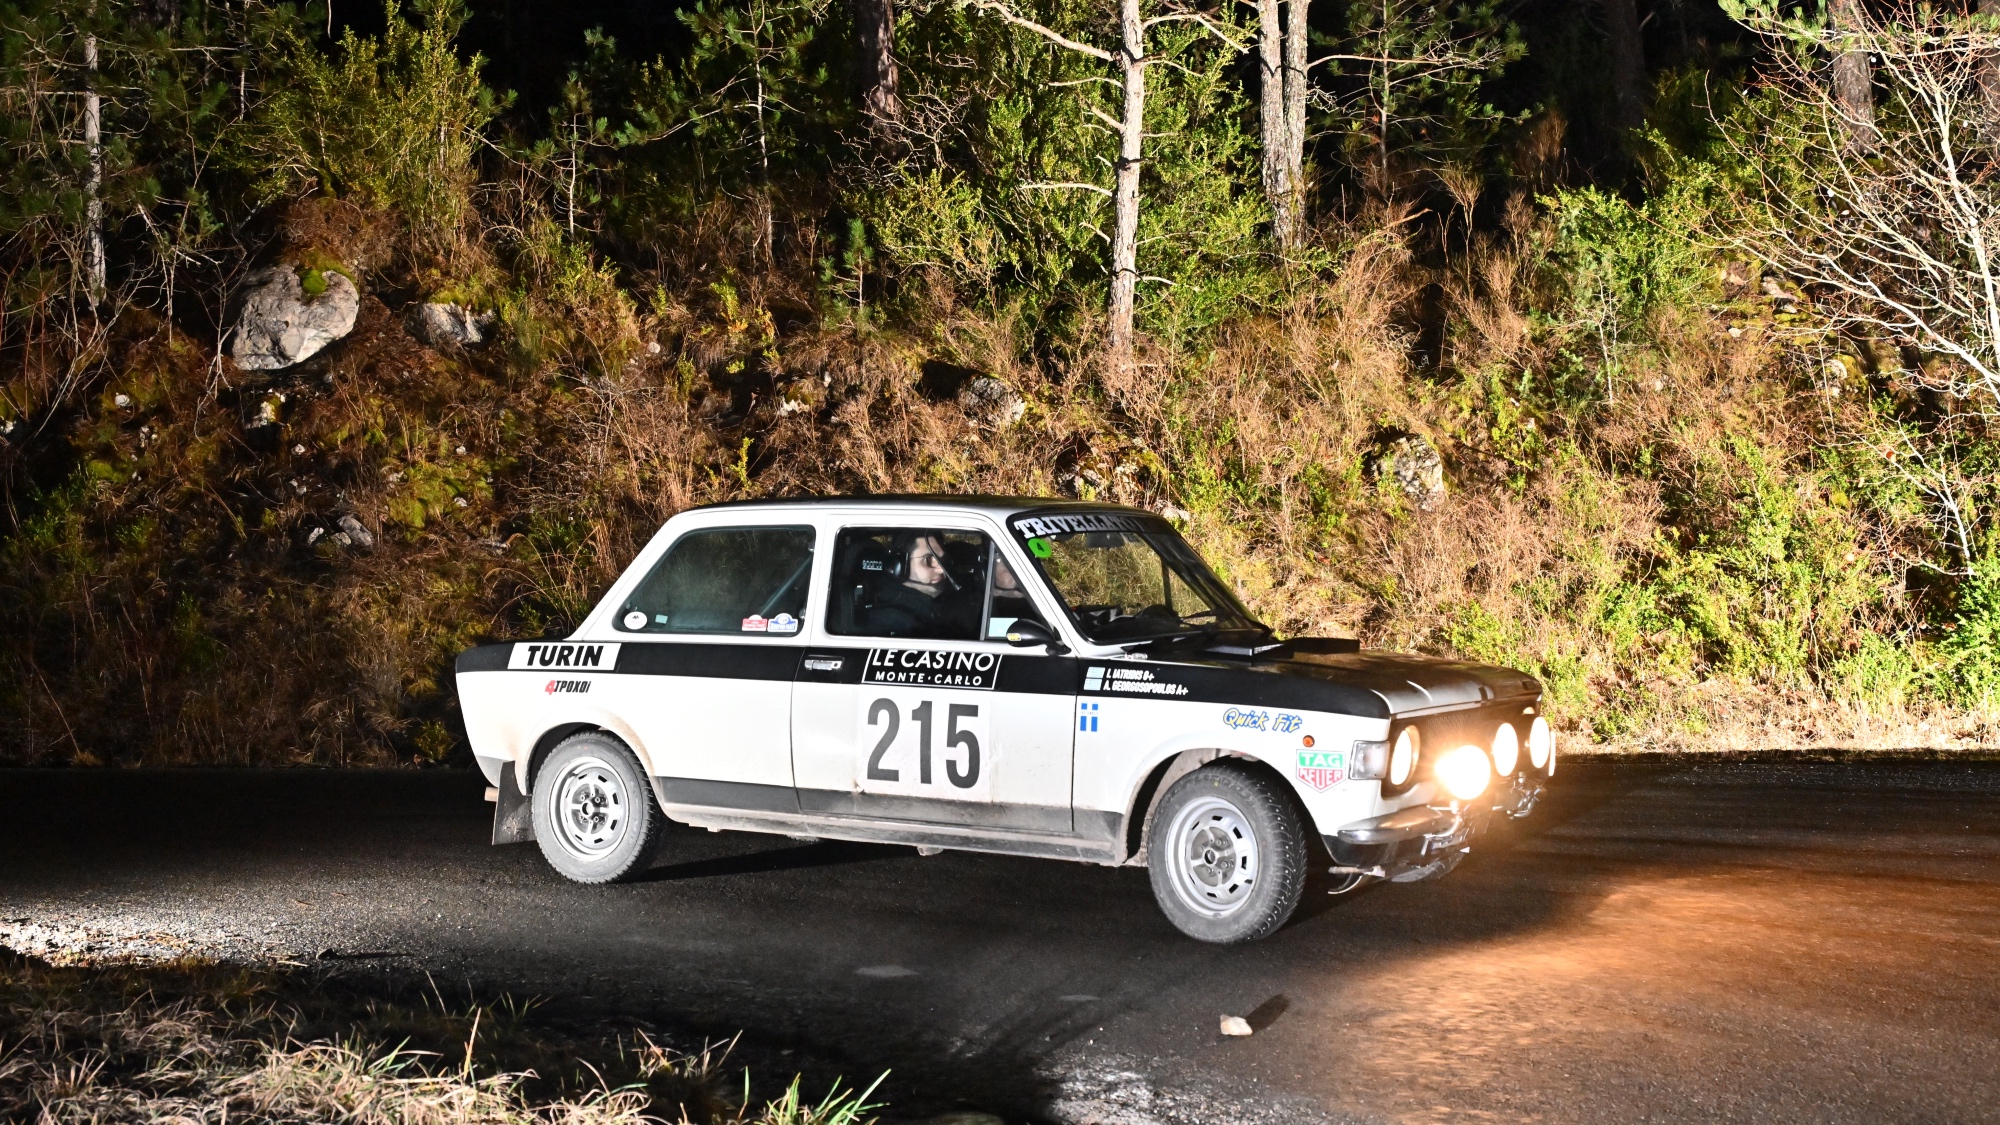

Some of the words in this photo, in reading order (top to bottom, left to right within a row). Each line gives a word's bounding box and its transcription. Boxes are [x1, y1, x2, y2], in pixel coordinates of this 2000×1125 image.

[527, 645, 604, 667] TURIN
[872, 648, 898, 667] LE
[900, 650, 995, 672] CASINO
[1223, 707, 1269, 732] Quick
[1272, 713, 1303, 733] Fit
[867, 697, 981, 789] 215
[1300, 753, 1343, 767] TAG
[1299, 768, 1343, 789] HEUER
